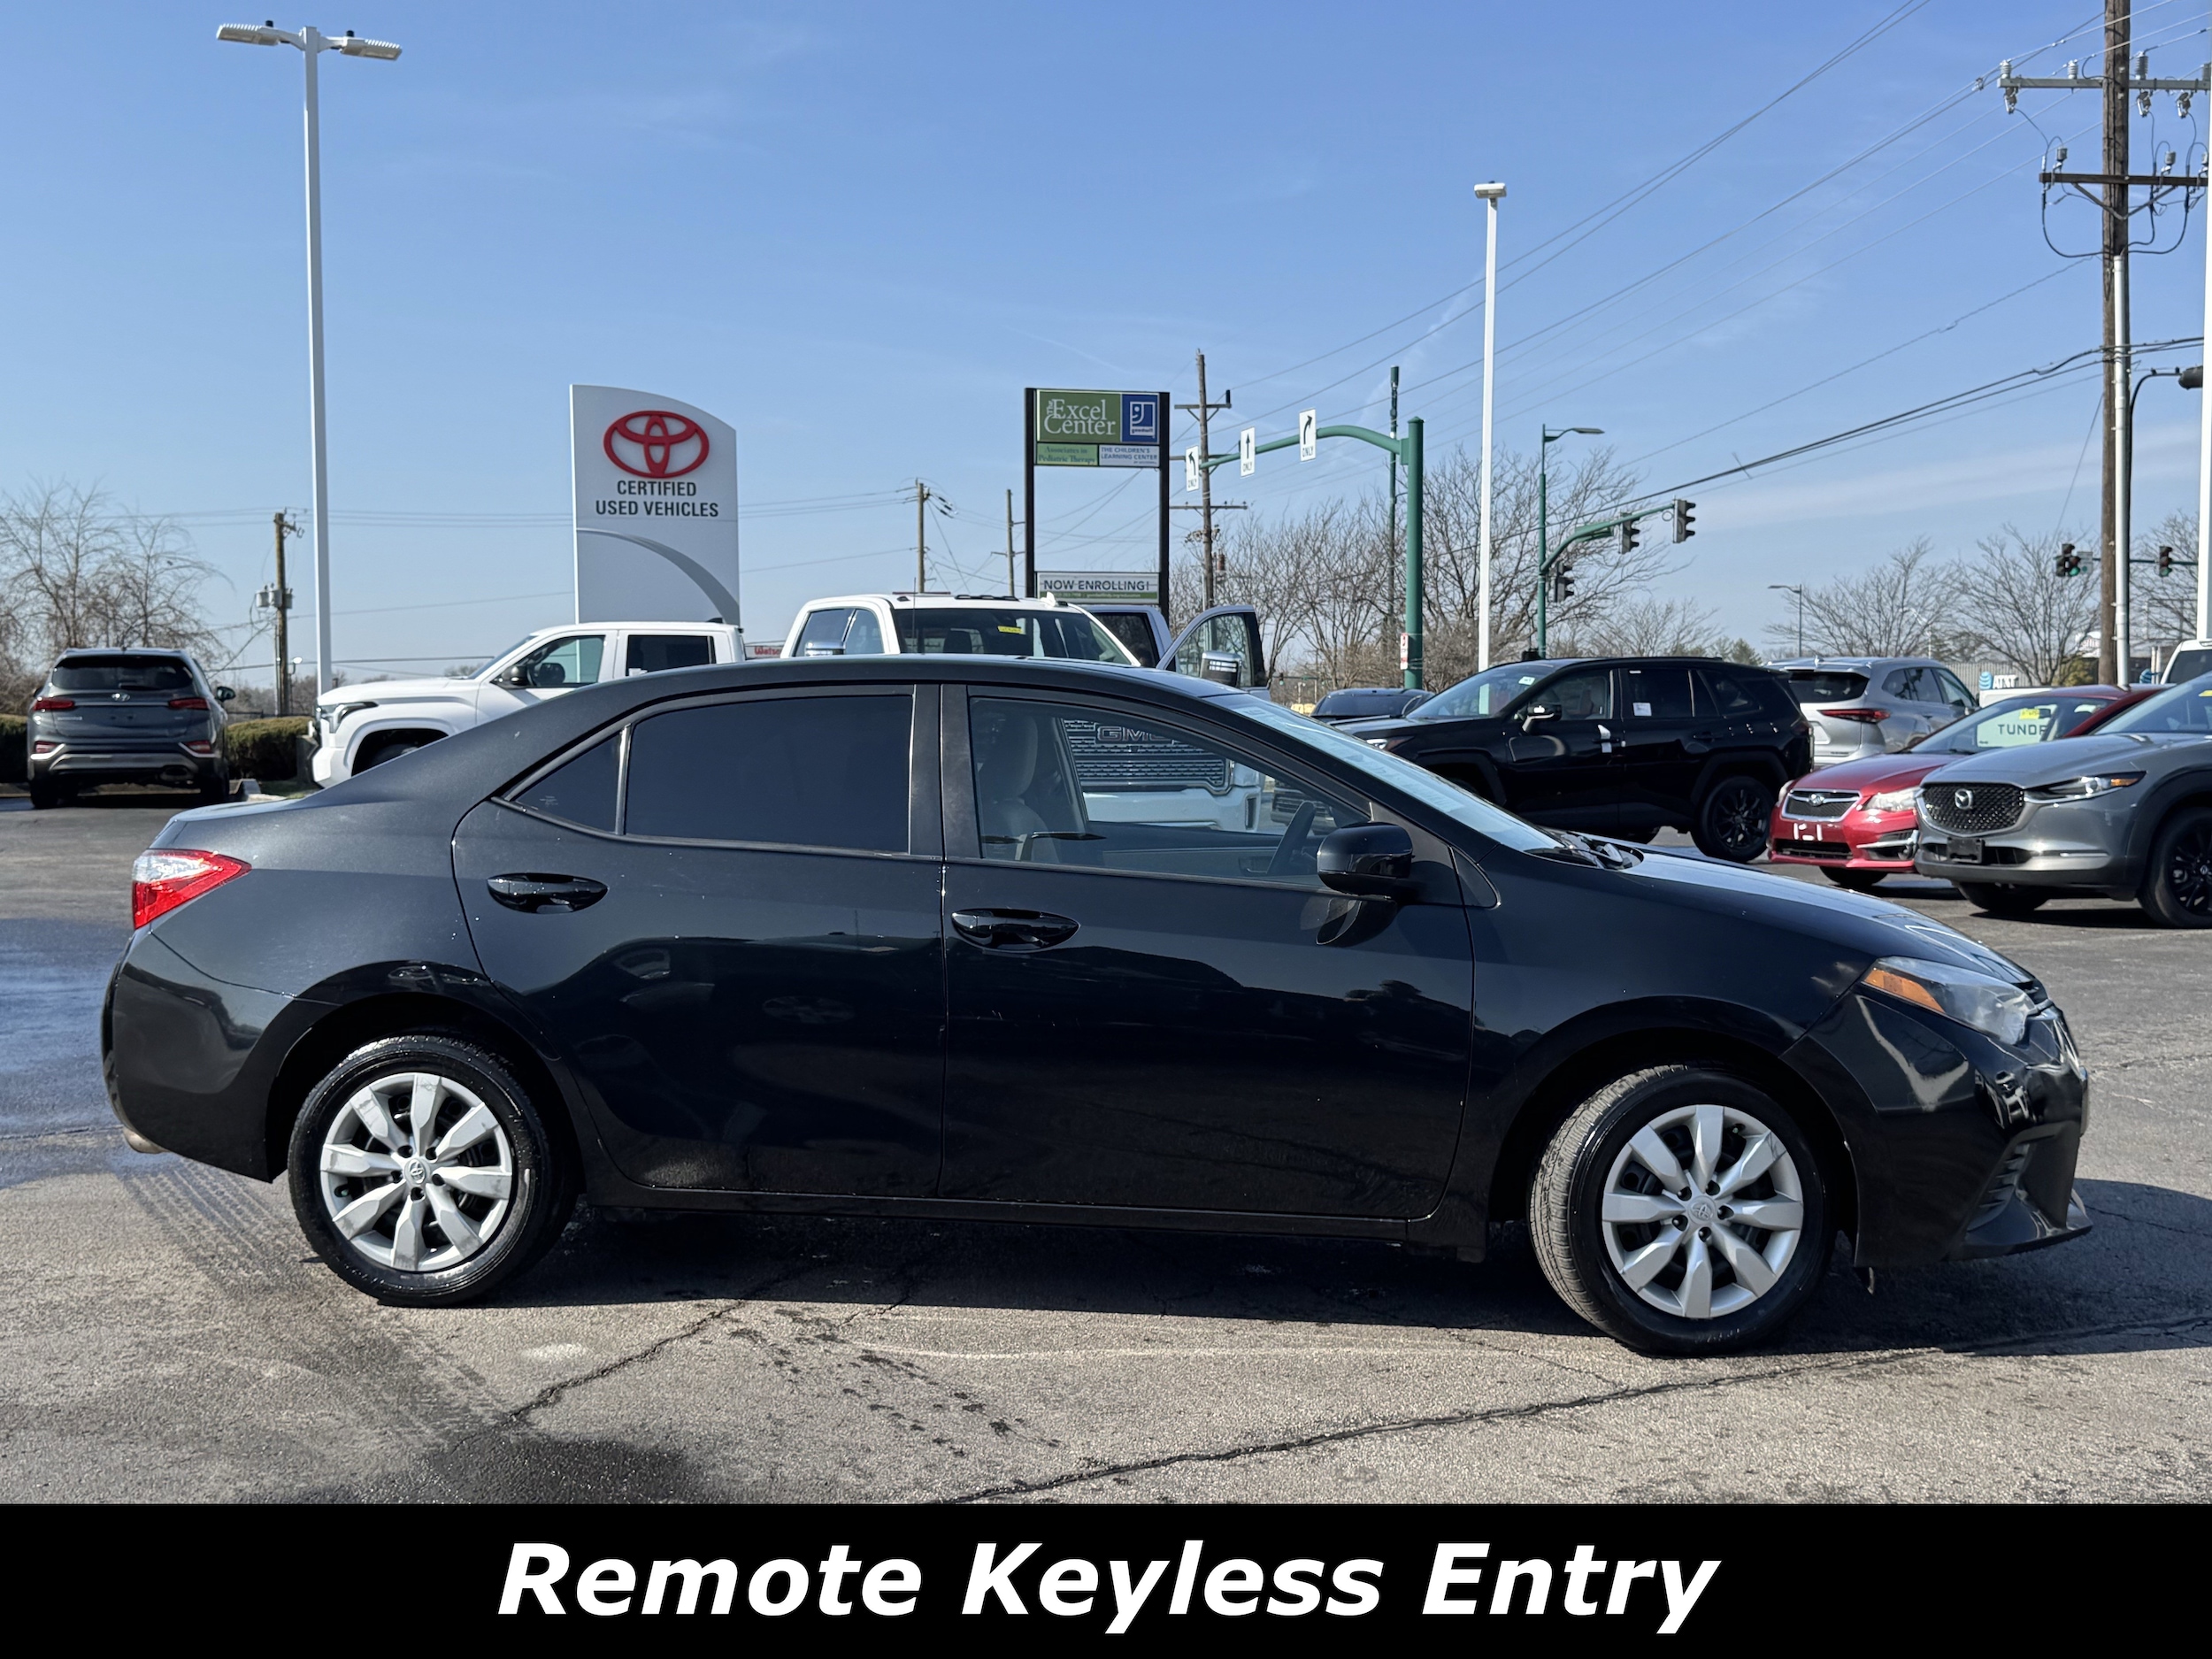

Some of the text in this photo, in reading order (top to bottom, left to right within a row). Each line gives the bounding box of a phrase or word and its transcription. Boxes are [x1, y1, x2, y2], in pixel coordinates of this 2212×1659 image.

[1052, 398, 1107, 420] Excel
[1044, 413, 1116, 435] Center
[1302, 446, 1313, 457] ONLY
[1242, 461, 1252, 472] ONLY
[617, 480, 697, 497] CERTIFIED
[1187, 479, 1197, 488] ONLY
[595, 500, 719, 518] USED VEHICLES
[1043, 580, 1149, 591] NOW ENROLLING!
[1993, 674, 2016, 688] AT&T
